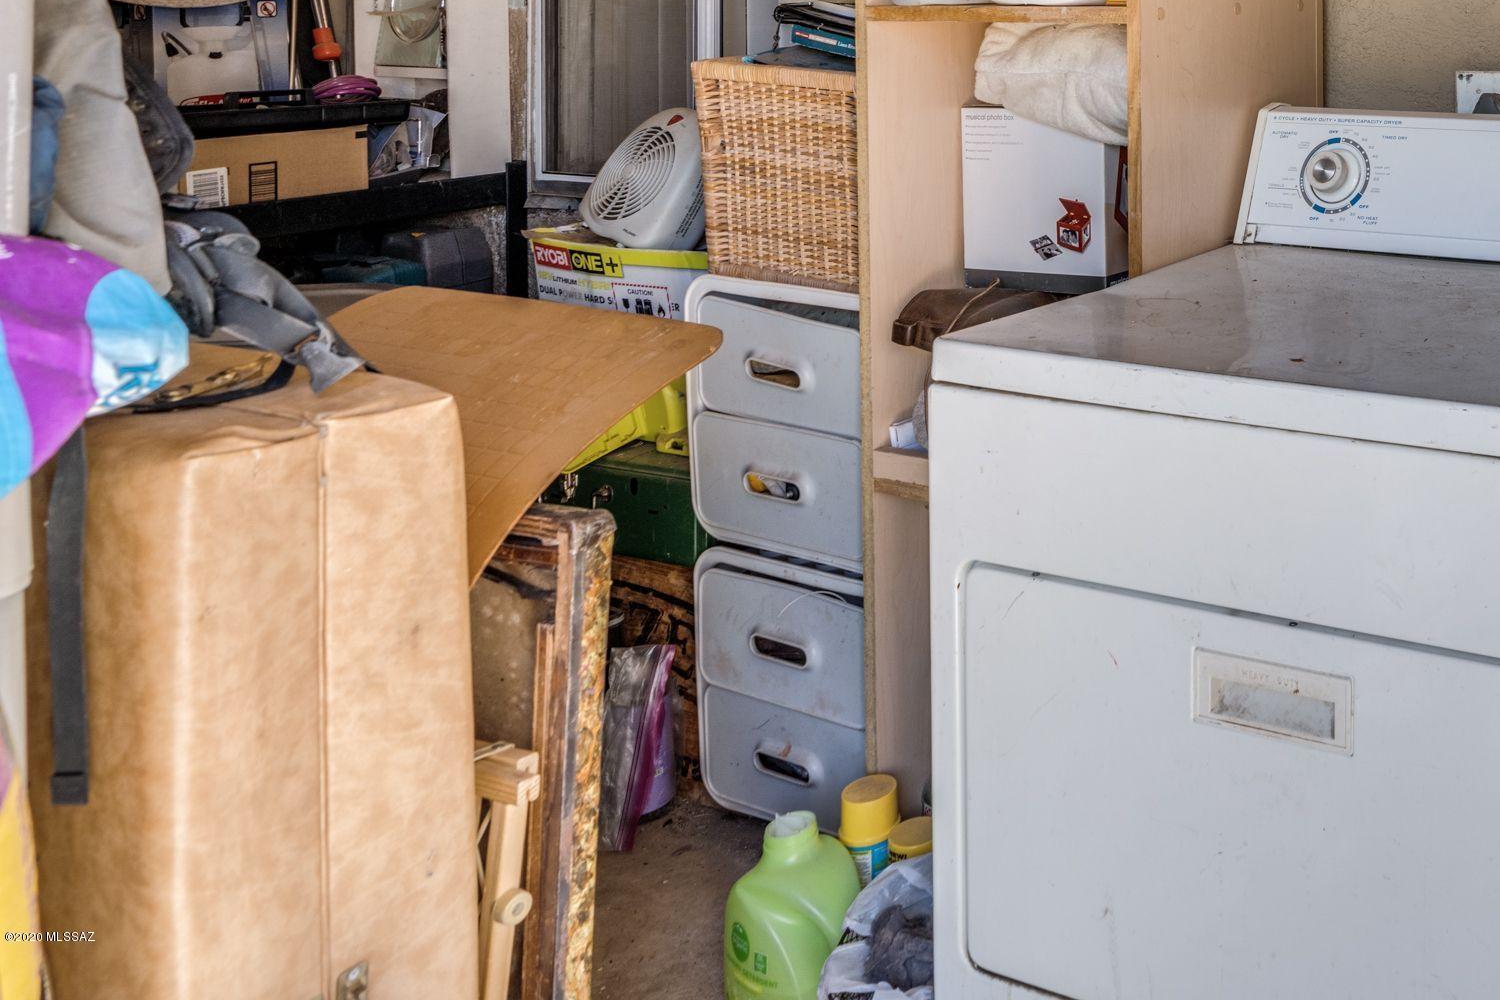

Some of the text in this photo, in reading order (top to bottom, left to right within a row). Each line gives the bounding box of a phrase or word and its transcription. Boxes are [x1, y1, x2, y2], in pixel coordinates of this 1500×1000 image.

[965, 113, 1015, 122] musical photo box
[534, 246, 569, 267] RYOBI
[552, 275, 578, 286] LITHIUM
[539, 285, 557, 296] DUAL
[584, 292, 606, 305] HARD
